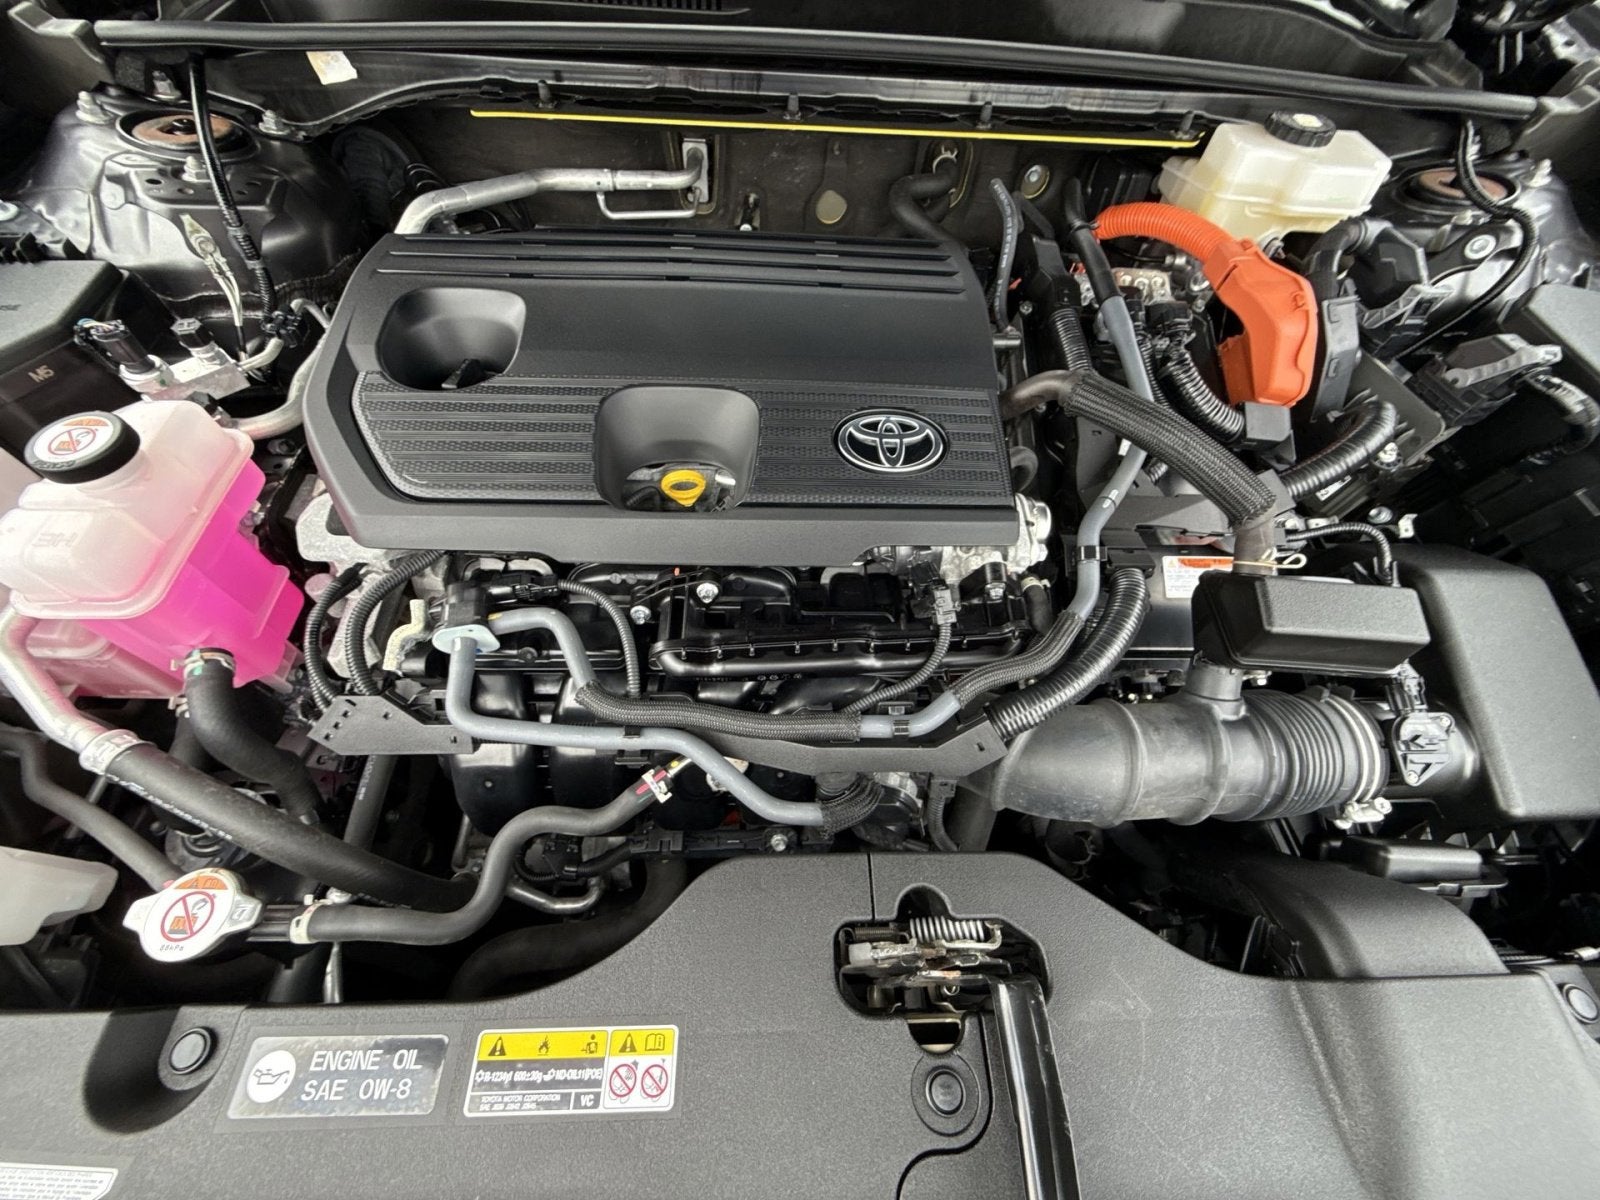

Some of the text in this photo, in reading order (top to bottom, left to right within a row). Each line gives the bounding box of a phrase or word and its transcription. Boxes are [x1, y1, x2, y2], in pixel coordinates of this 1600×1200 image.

[310, 1049, 423, 1071] ENGINE OIL
[301, 1078, 412, 1101] SAE 0W-8
[481, 1094, 561, 1104] TOYOTA MOTOR CORPORATION
[580, 1094, 594, 1107] VC
